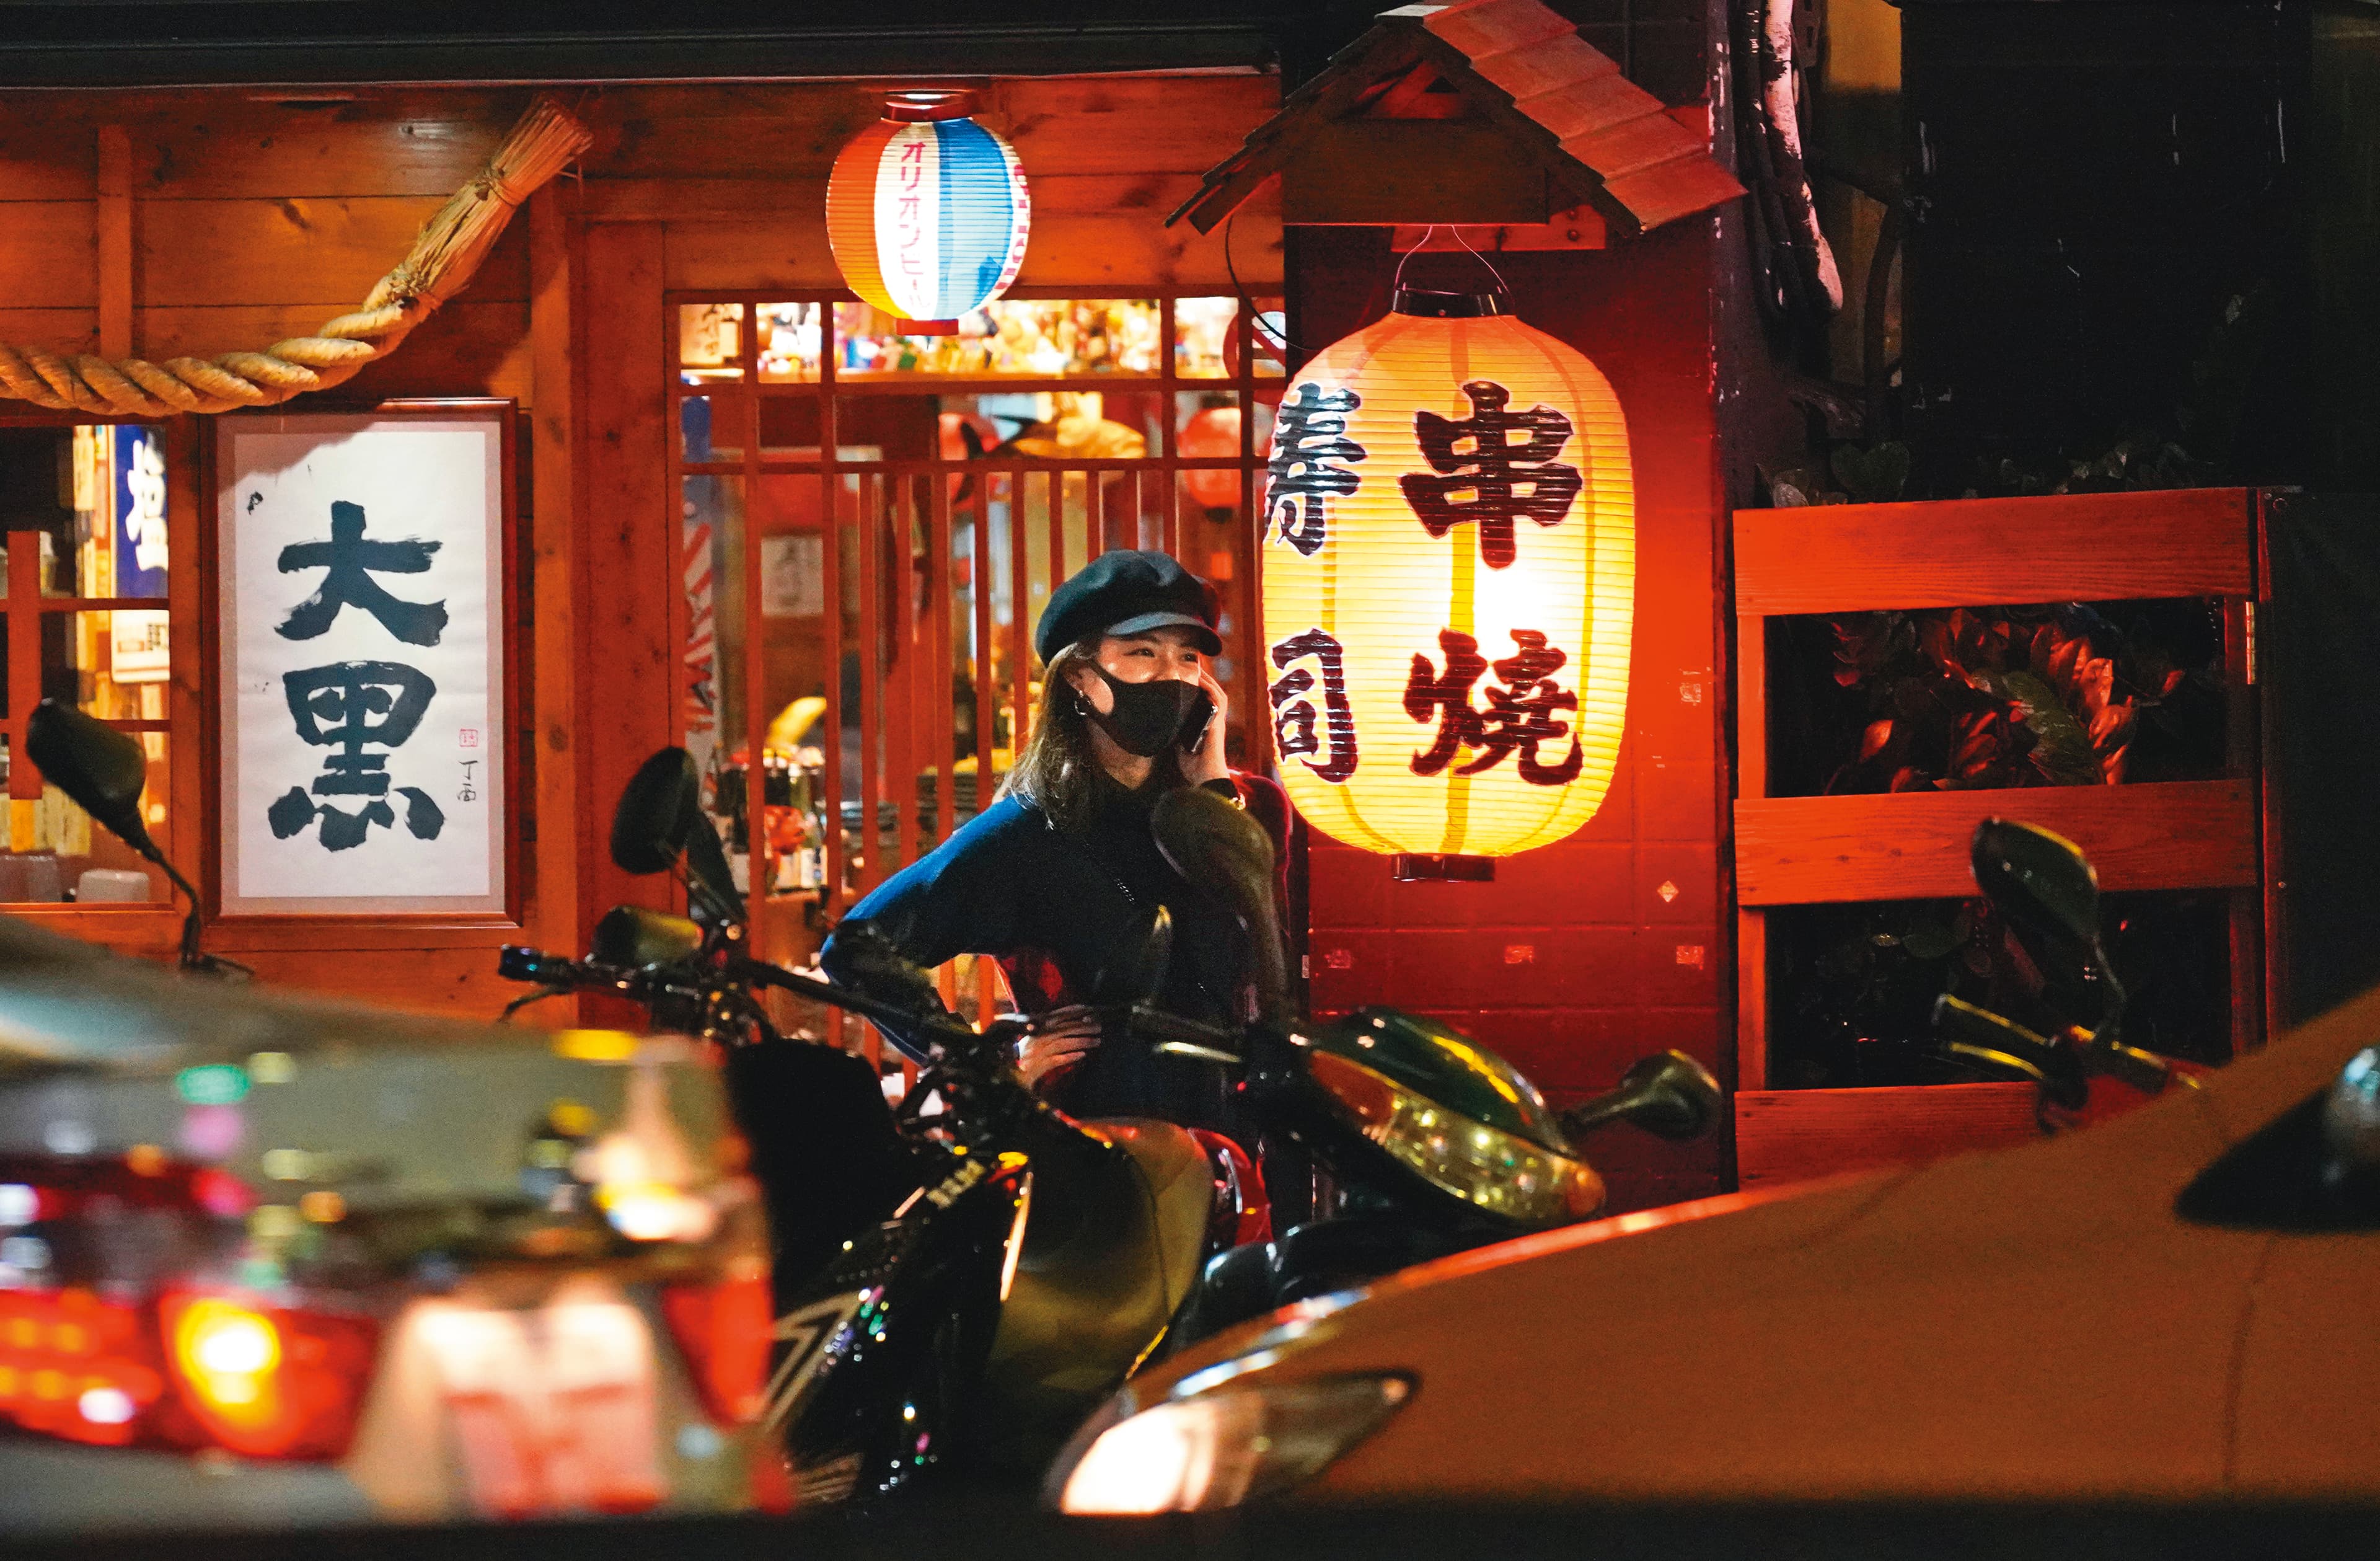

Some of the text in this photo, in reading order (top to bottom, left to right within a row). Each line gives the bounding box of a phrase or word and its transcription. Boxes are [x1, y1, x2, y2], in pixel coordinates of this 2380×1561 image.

[898, 141, 930, 309] オリオンビール
